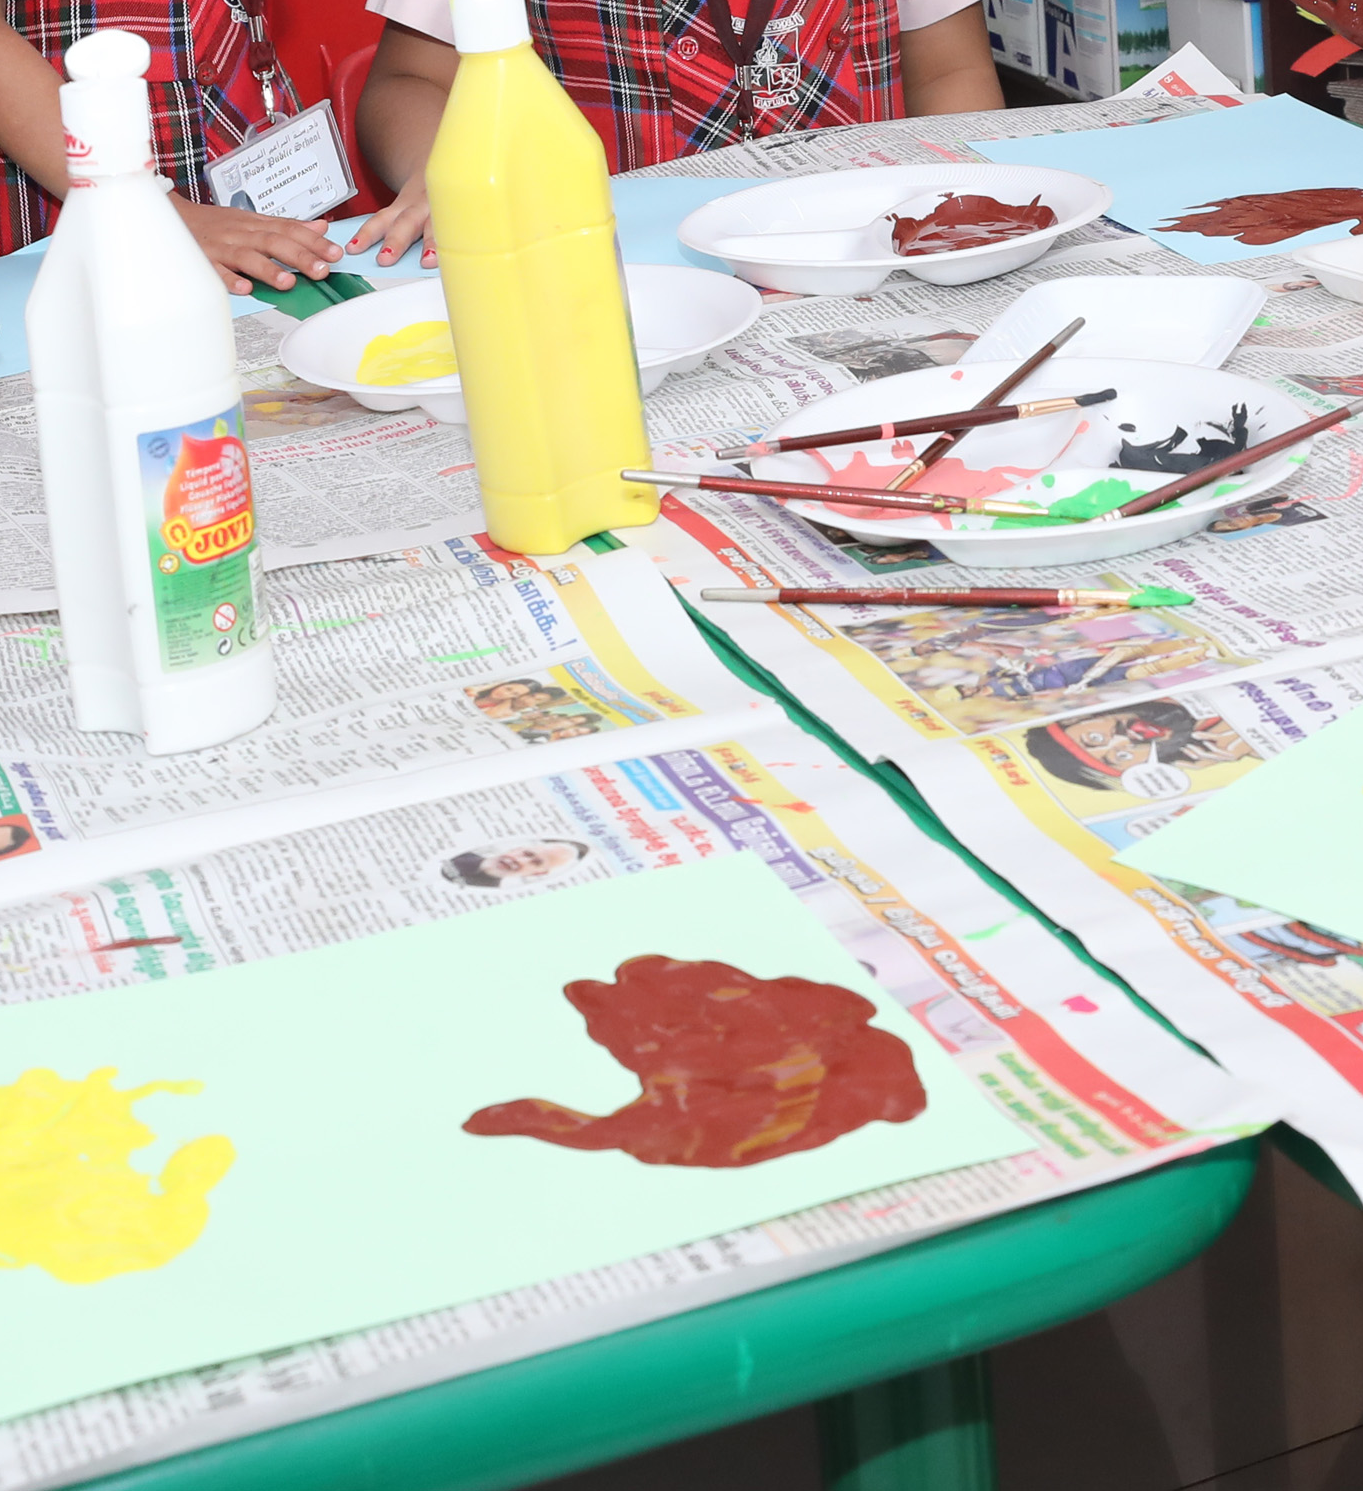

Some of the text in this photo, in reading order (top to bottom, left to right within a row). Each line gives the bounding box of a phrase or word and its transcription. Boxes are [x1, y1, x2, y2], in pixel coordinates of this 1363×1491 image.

[266, 148, 293, 171] Public
[294, 131, 322, 153] School
[297, 161, 319, 181] PANDIT
[194, 514, 249, 555] JOVI
